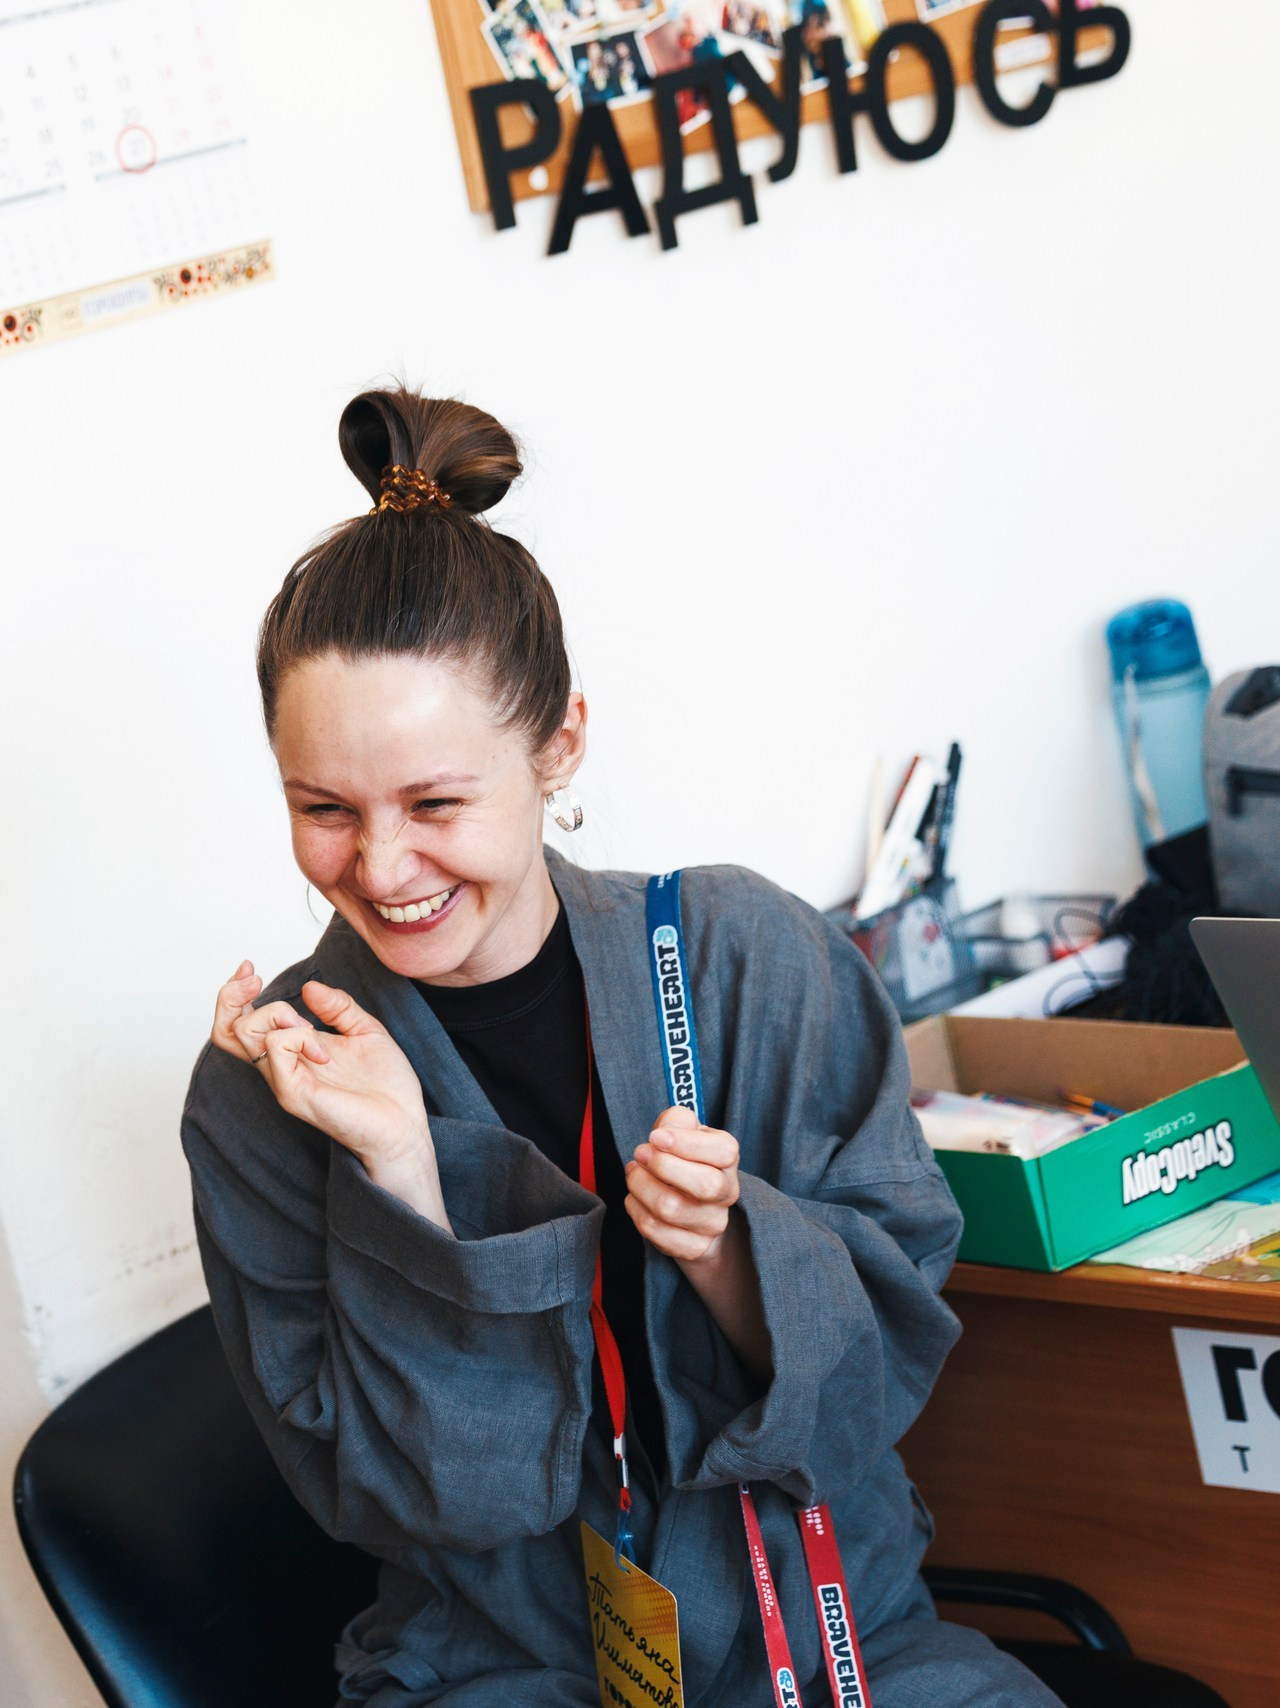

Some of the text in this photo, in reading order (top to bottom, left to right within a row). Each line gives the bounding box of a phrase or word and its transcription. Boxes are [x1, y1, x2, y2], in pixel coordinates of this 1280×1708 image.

[25, 63, 36, 80] 4
[468, 0, 1132, 256] РАДУЮСЬ
[1122, 1120, 1234, 1206] SvetoCopy
[1143, 1112, 1197, 1145] CLASSIC
[589, 1572, 680, 1685] Татьяна
